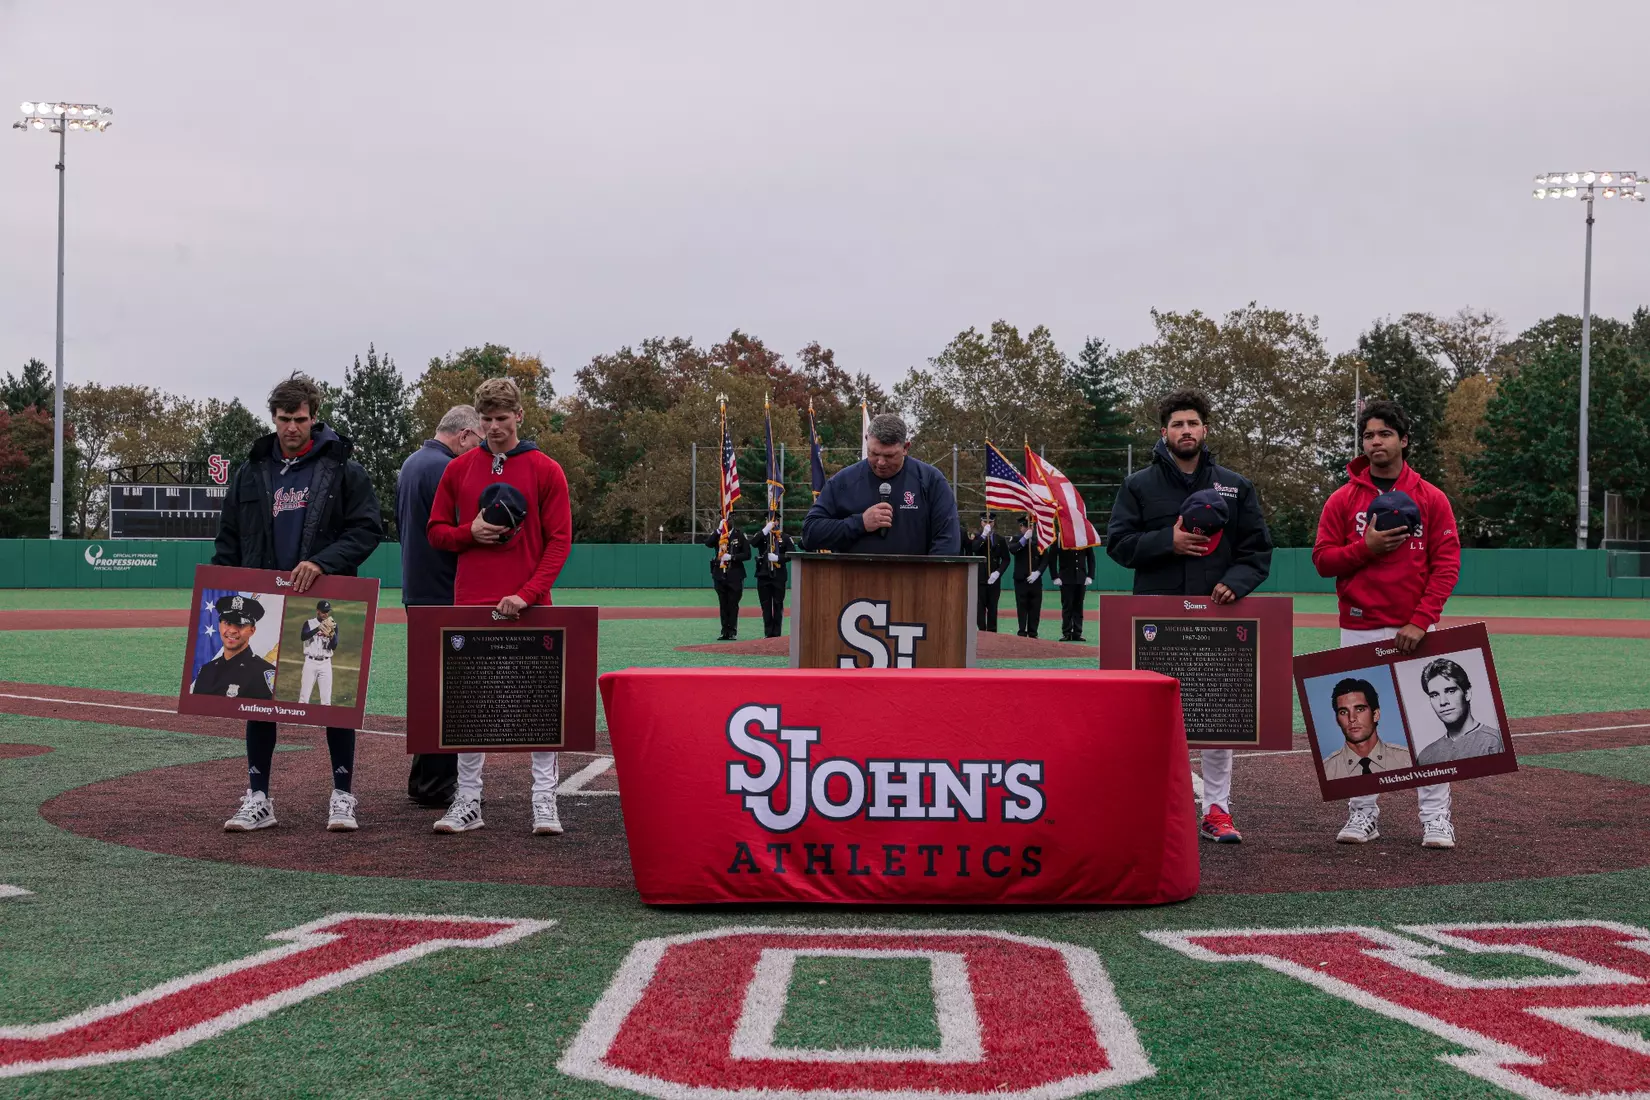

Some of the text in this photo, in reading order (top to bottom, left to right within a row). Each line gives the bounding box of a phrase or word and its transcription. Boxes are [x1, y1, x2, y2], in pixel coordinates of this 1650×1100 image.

[123, 488, 142, 496] AT BAT
[166, 488, 180, 497] BALL
[194, 511, 198, 519] 5
[238, 703, 306, 720] Anthony Varvaro
[1379, 766, 1458, 785] Michael Weinburg
[727, 842, 1042, 879] ATHLETICS
